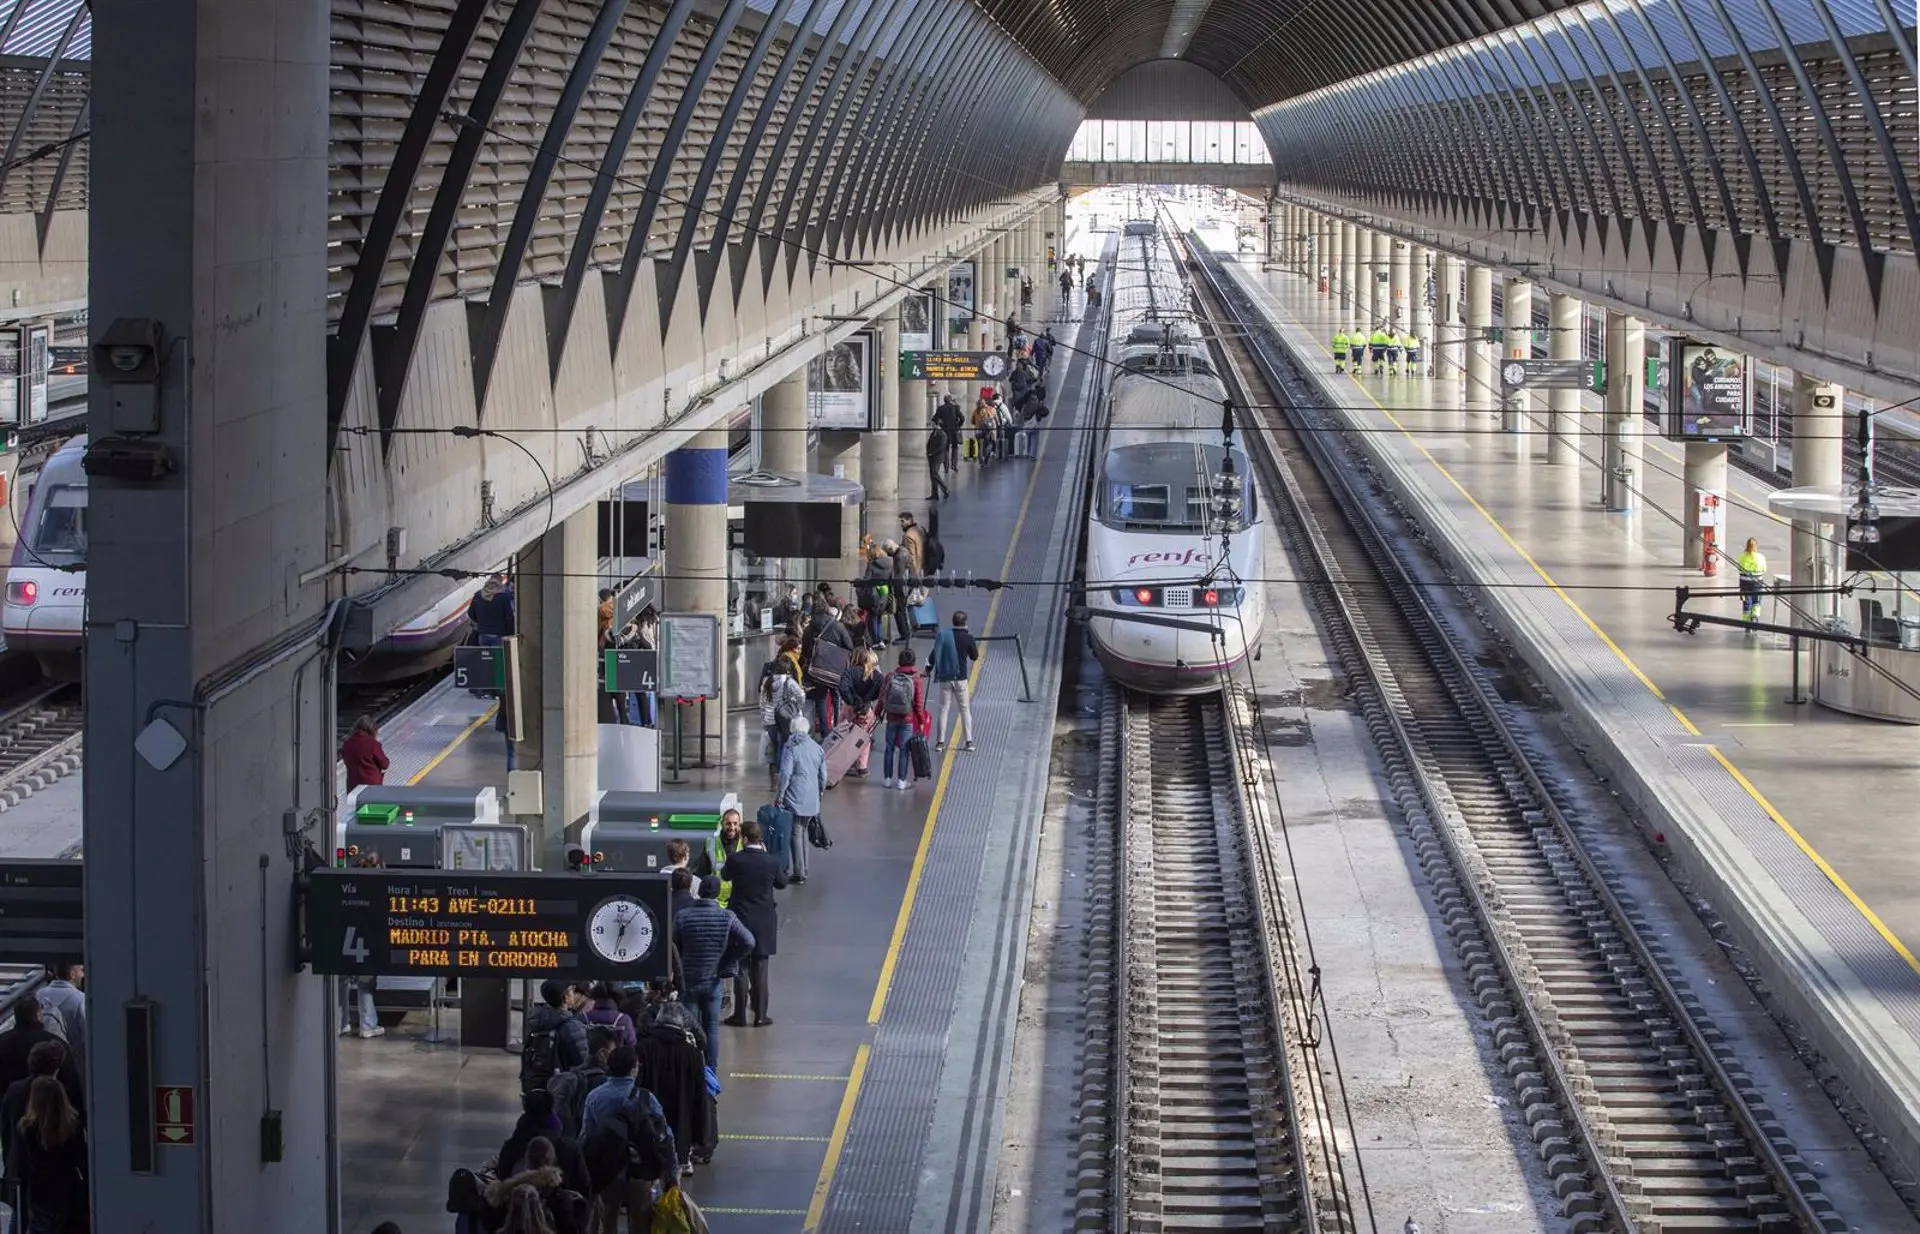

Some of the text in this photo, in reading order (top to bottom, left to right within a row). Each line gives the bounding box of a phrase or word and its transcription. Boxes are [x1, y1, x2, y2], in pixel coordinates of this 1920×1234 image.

[912, 365, 920, 377] 4
[1586, 375, 1594, 387] 3
[1127, 548, 1212, 567] renfe
[457, 667, 468, 686] 5
[641, 671, 655, 689] 4
[341, 883, 357, 894] Vía
[388, 885, 410, 895] Hora
[447, 886, 469, 896] Tren
[389, 897, 537, 915] 11:43 AVE-02111
[616, 904, 628, 913] 12
[388, 917, 425, 927] Destino
[596, 926, 604, 934] 9
[641, 927, 649, 935] 3
[390, 929, 569, 947] MADRID PTA. ATOCHA
[342, 926, 370, 963] 4
[410, 949, 559, 968] PARA EN CORDOBA
